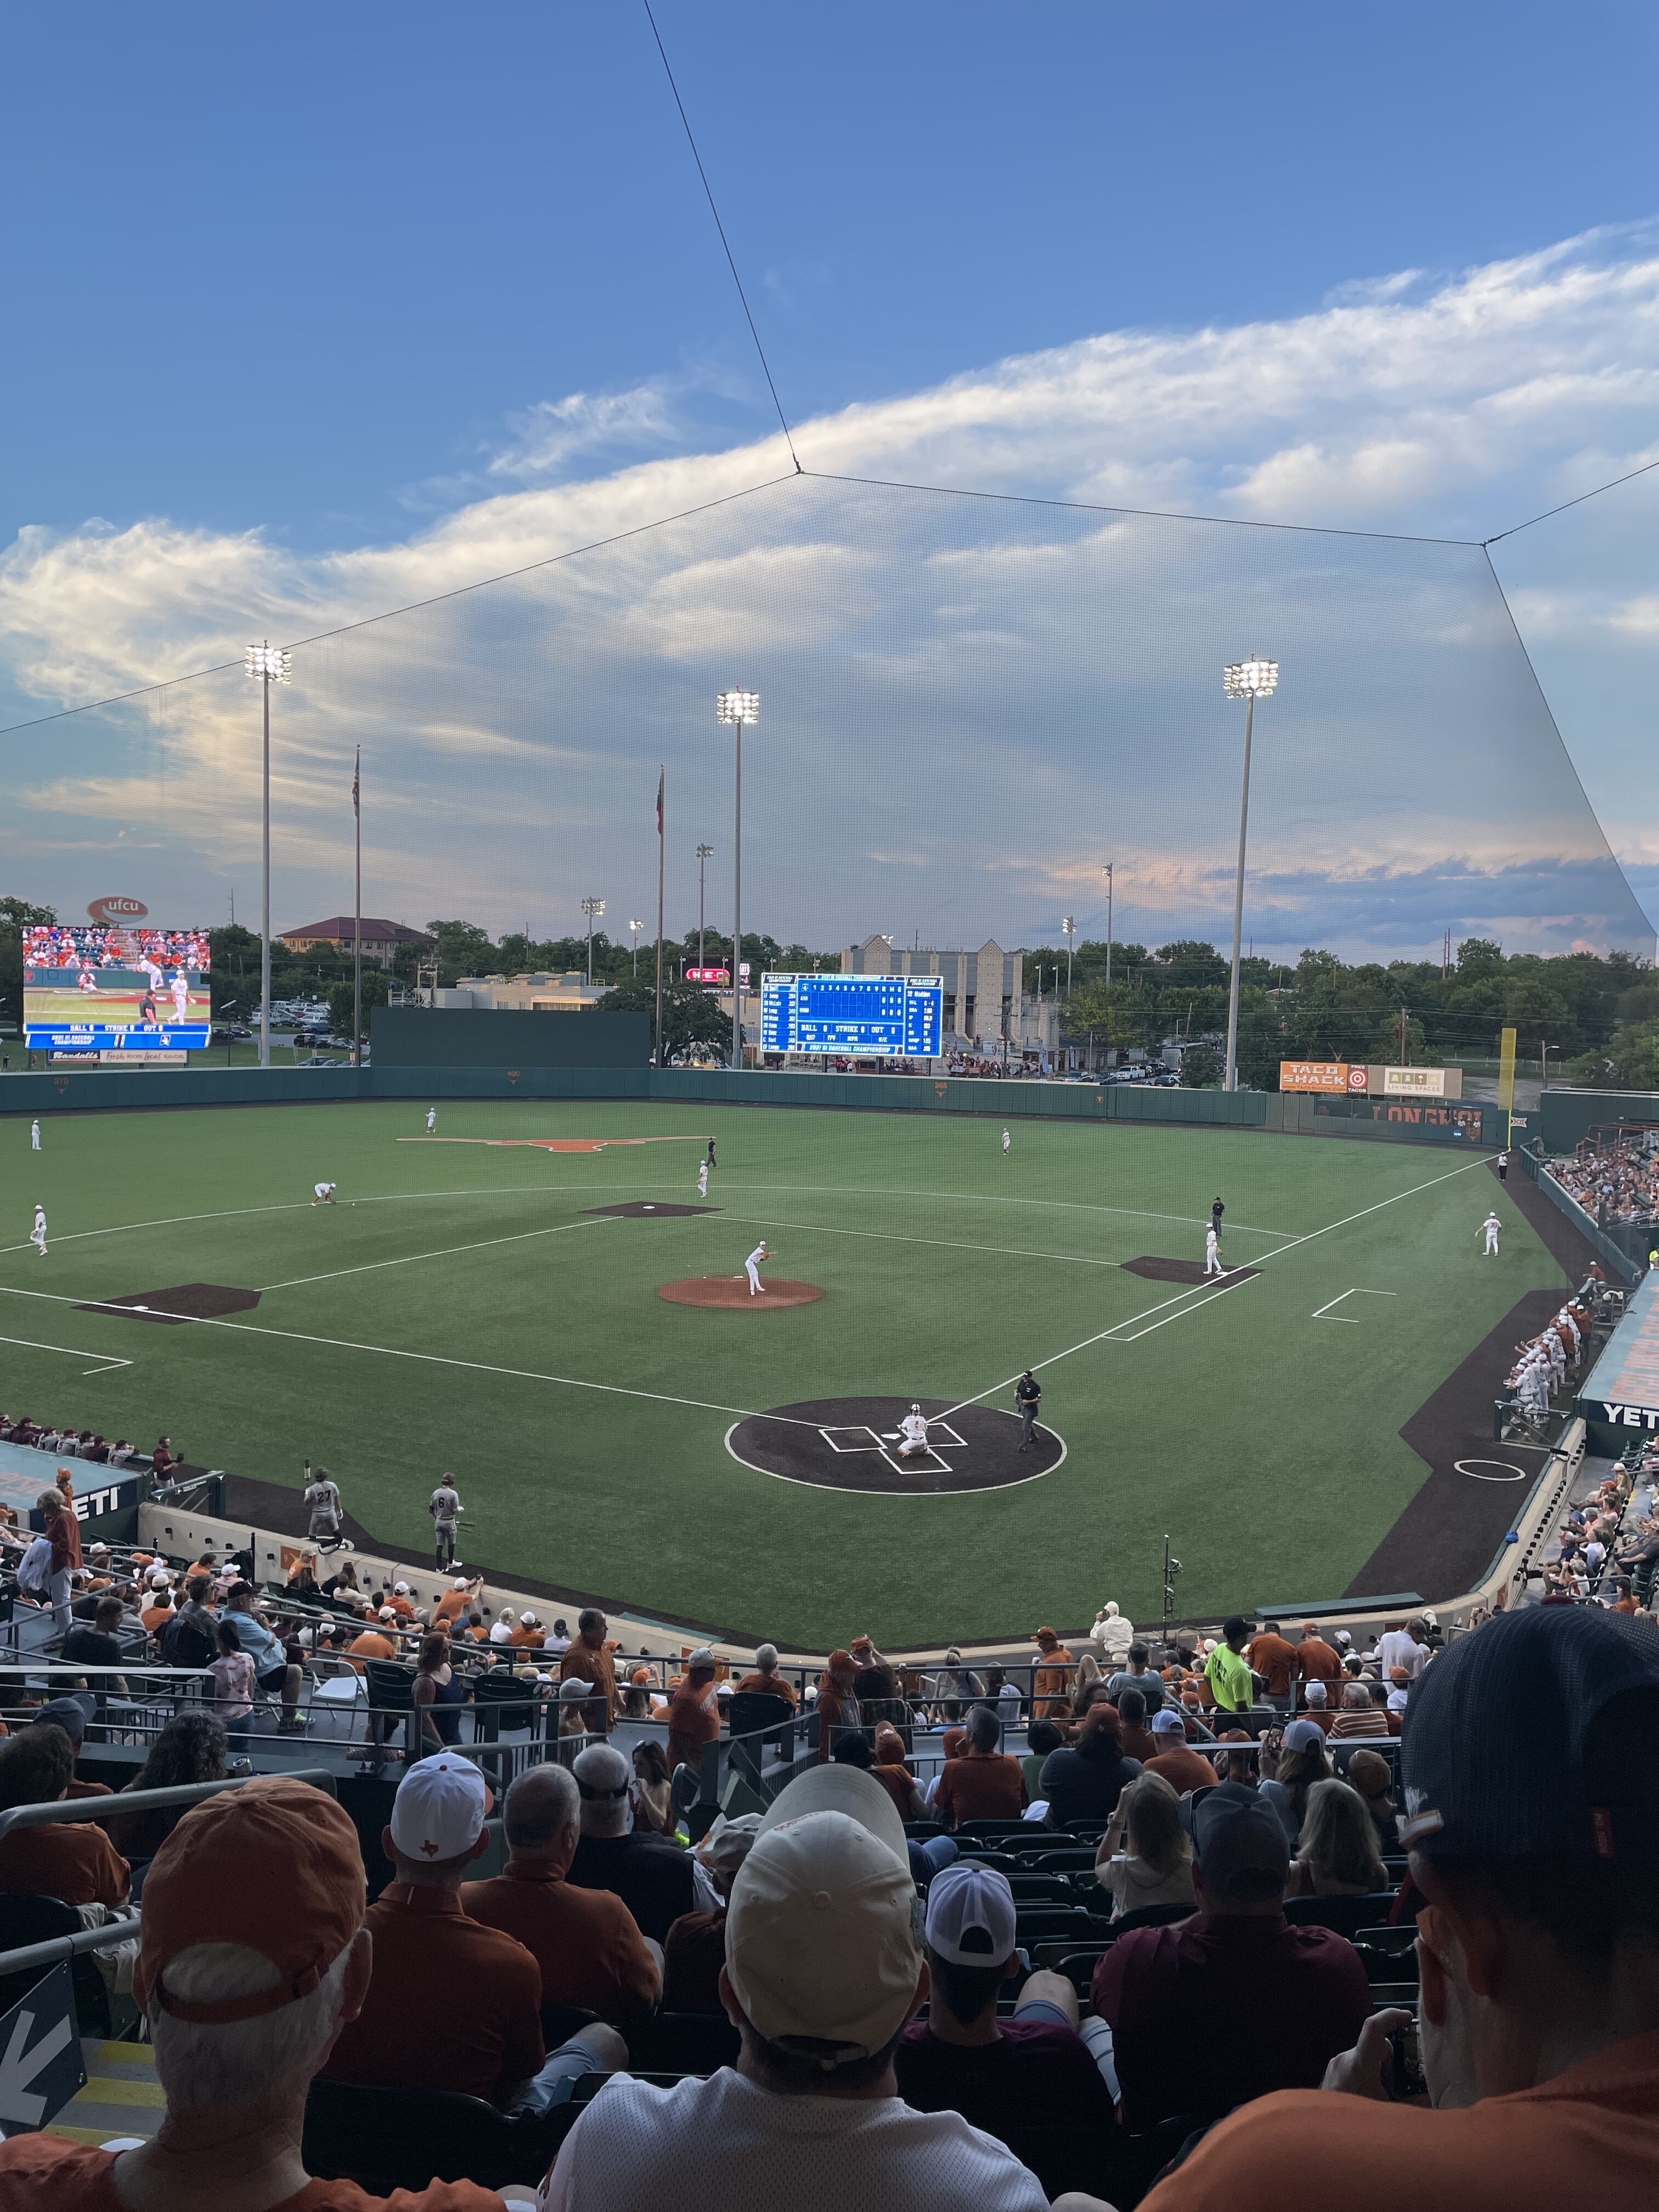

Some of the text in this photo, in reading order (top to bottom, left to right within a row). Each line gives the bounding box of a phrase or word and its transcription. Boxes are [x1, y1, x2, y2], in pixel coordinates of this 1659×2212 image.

[109, 899, 138, 911] ufcu
[106, 1052, 125, 1060] Fresh
[143, 1051, 161, 1060] Local
[1289, 1064, 1339, 1075] TACO
[1283, 1074, 1346, 1085] SHACK
[317, 1490, 331, 1503] 27
[438, 1497, 444, 1508] 6
